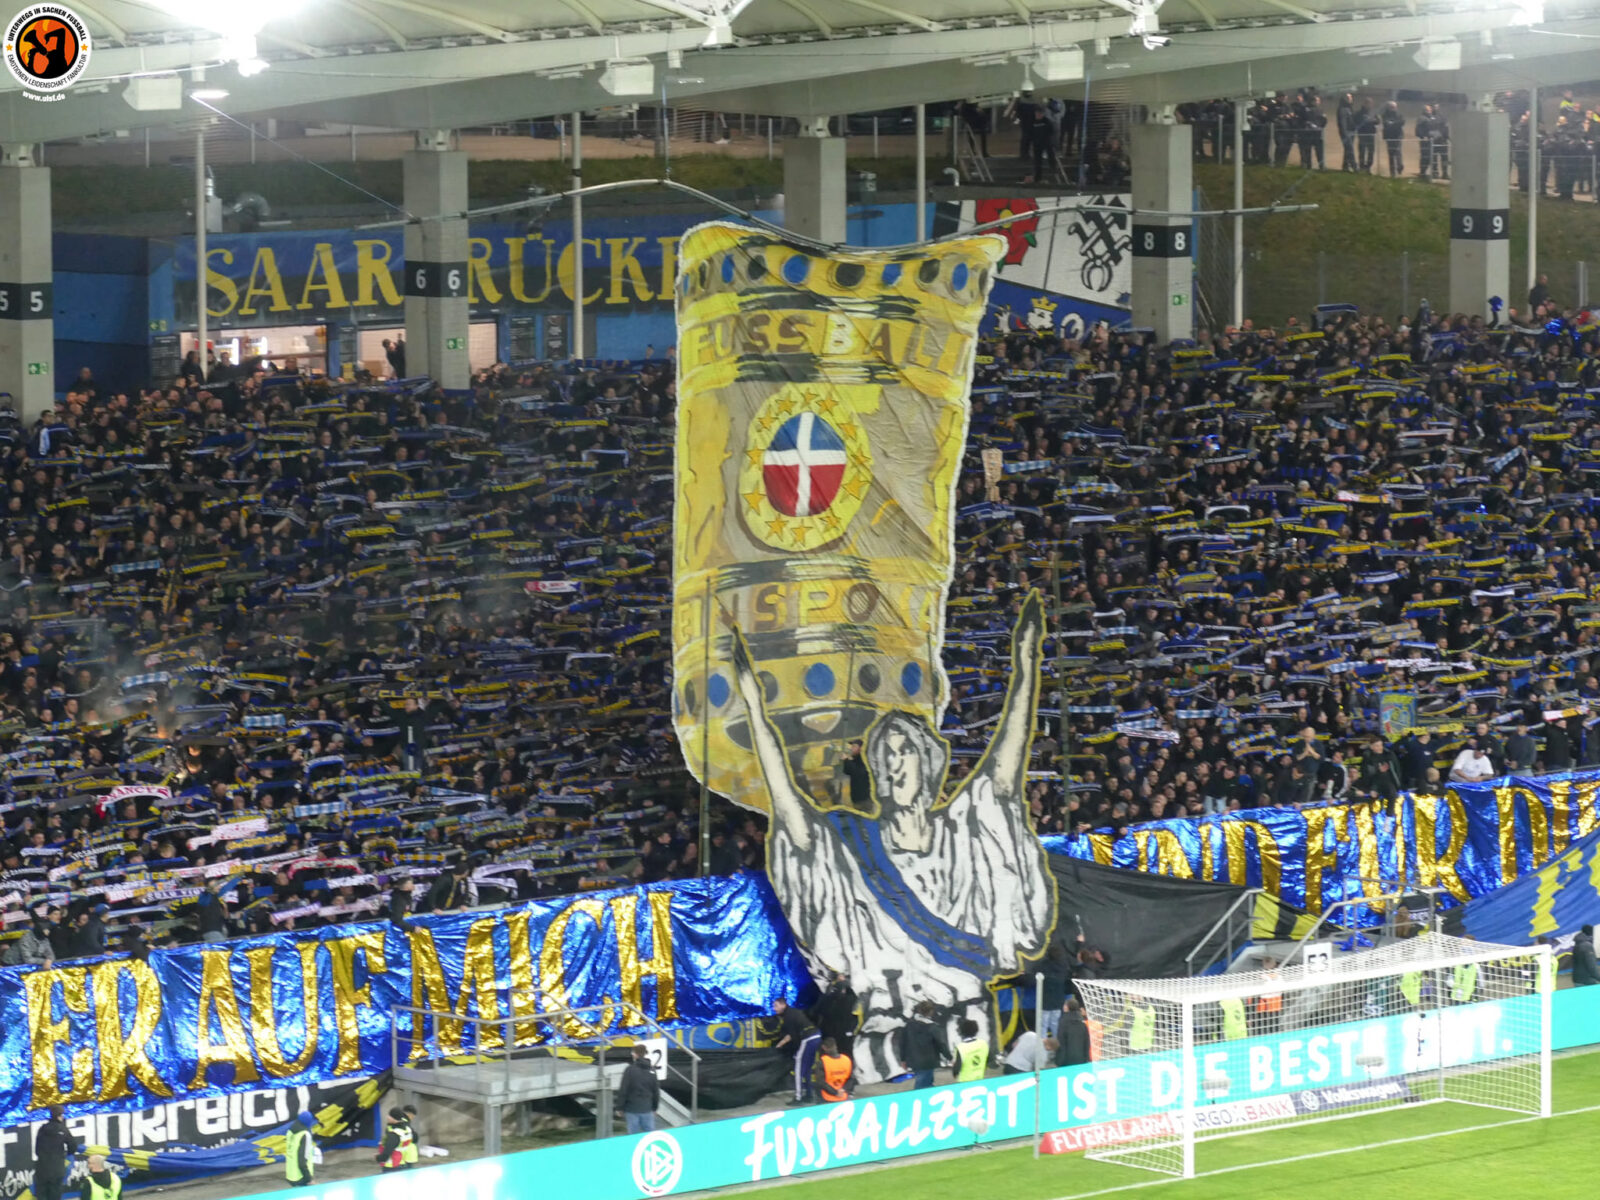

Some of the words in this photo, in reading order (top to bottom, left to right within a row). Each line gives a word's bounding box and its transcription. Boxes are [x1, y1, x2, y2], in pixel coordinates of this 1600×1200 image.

[1463, 216, 1474, 233] 9
[1492, 216, 1504, 234] 9
[1144, 232, 1155, 251] 8
[1174, 232, 1186, 251] 8
[415, 269, 427, 290] 6
[447, 269, 460, 290] 6
[30, 291, 44, 313] 5
[1300, 788, 1473, 914] FÜR
[20, 958, 174, 1112] ER
[187, 931, 388, 1090] AUF
[407, 891, 681, 1061] MICH
[1321, 1082, 1403, 1104] Volkswagen
[740, 1079, 1038, 1181] FUSSBALLZEIT
[1056, 1067, 1126, 1122] IST
[1150, 1052, 1230, 1107] DIE
[1051, 1116, 1172, 1151] FLYERALARM
